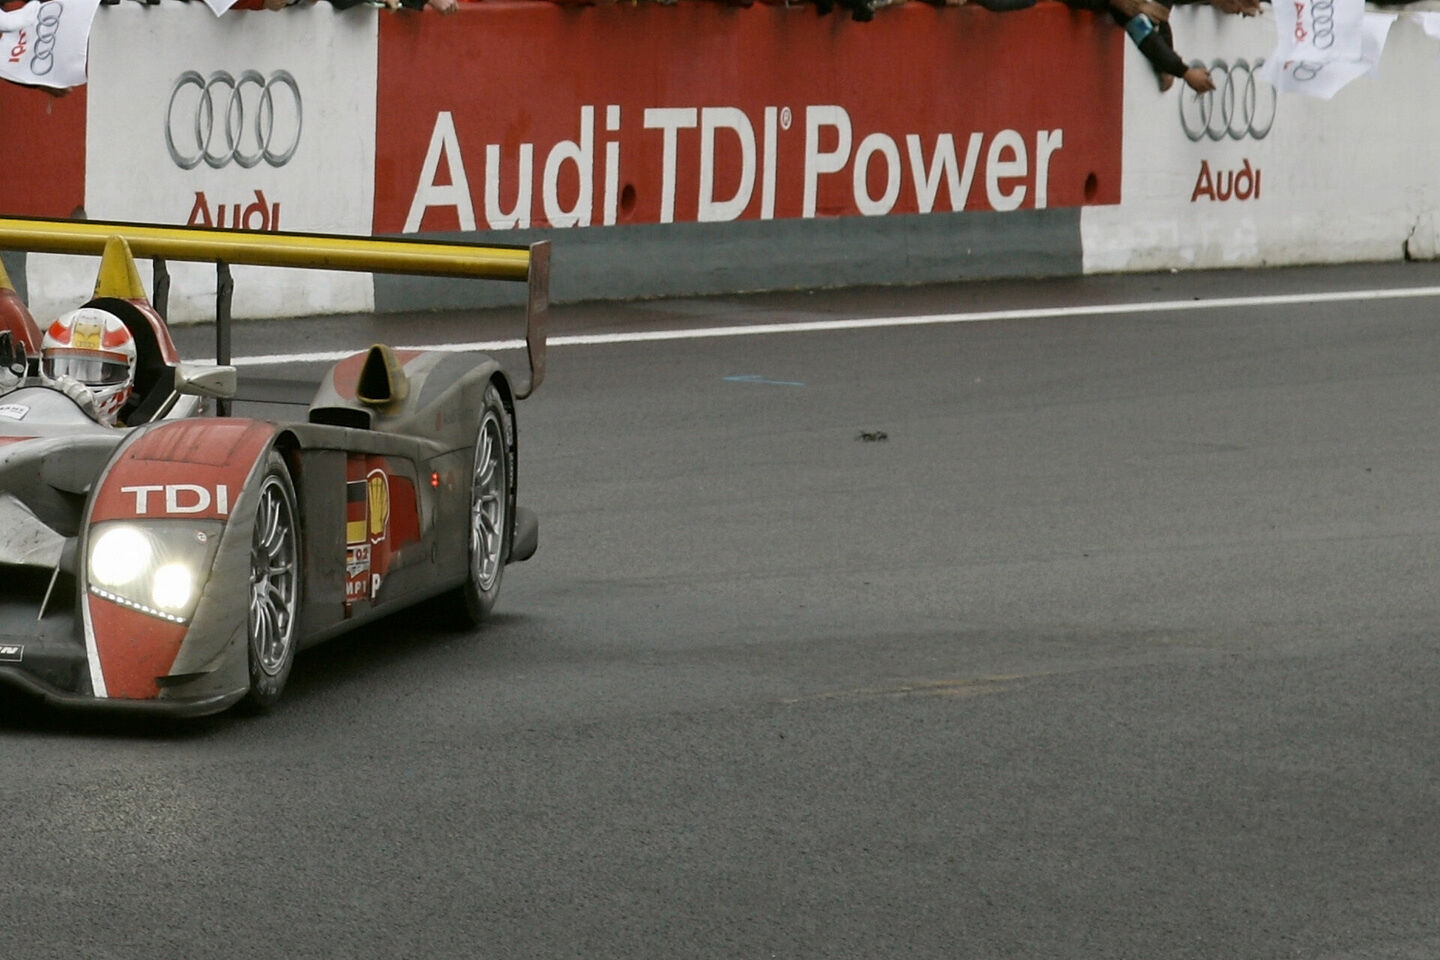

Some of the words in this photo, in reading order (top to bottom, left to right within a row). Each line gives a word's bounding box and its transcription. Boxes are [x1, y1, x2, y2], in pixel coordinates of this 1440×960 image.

[402, 105, 620, 234] Audi
[802, 104, 1063, 220] Power
[1191, 158, 1261, 203] Audi
[186, 189, 280, 232] Audi
[120, 484, 228, 515] TDI
